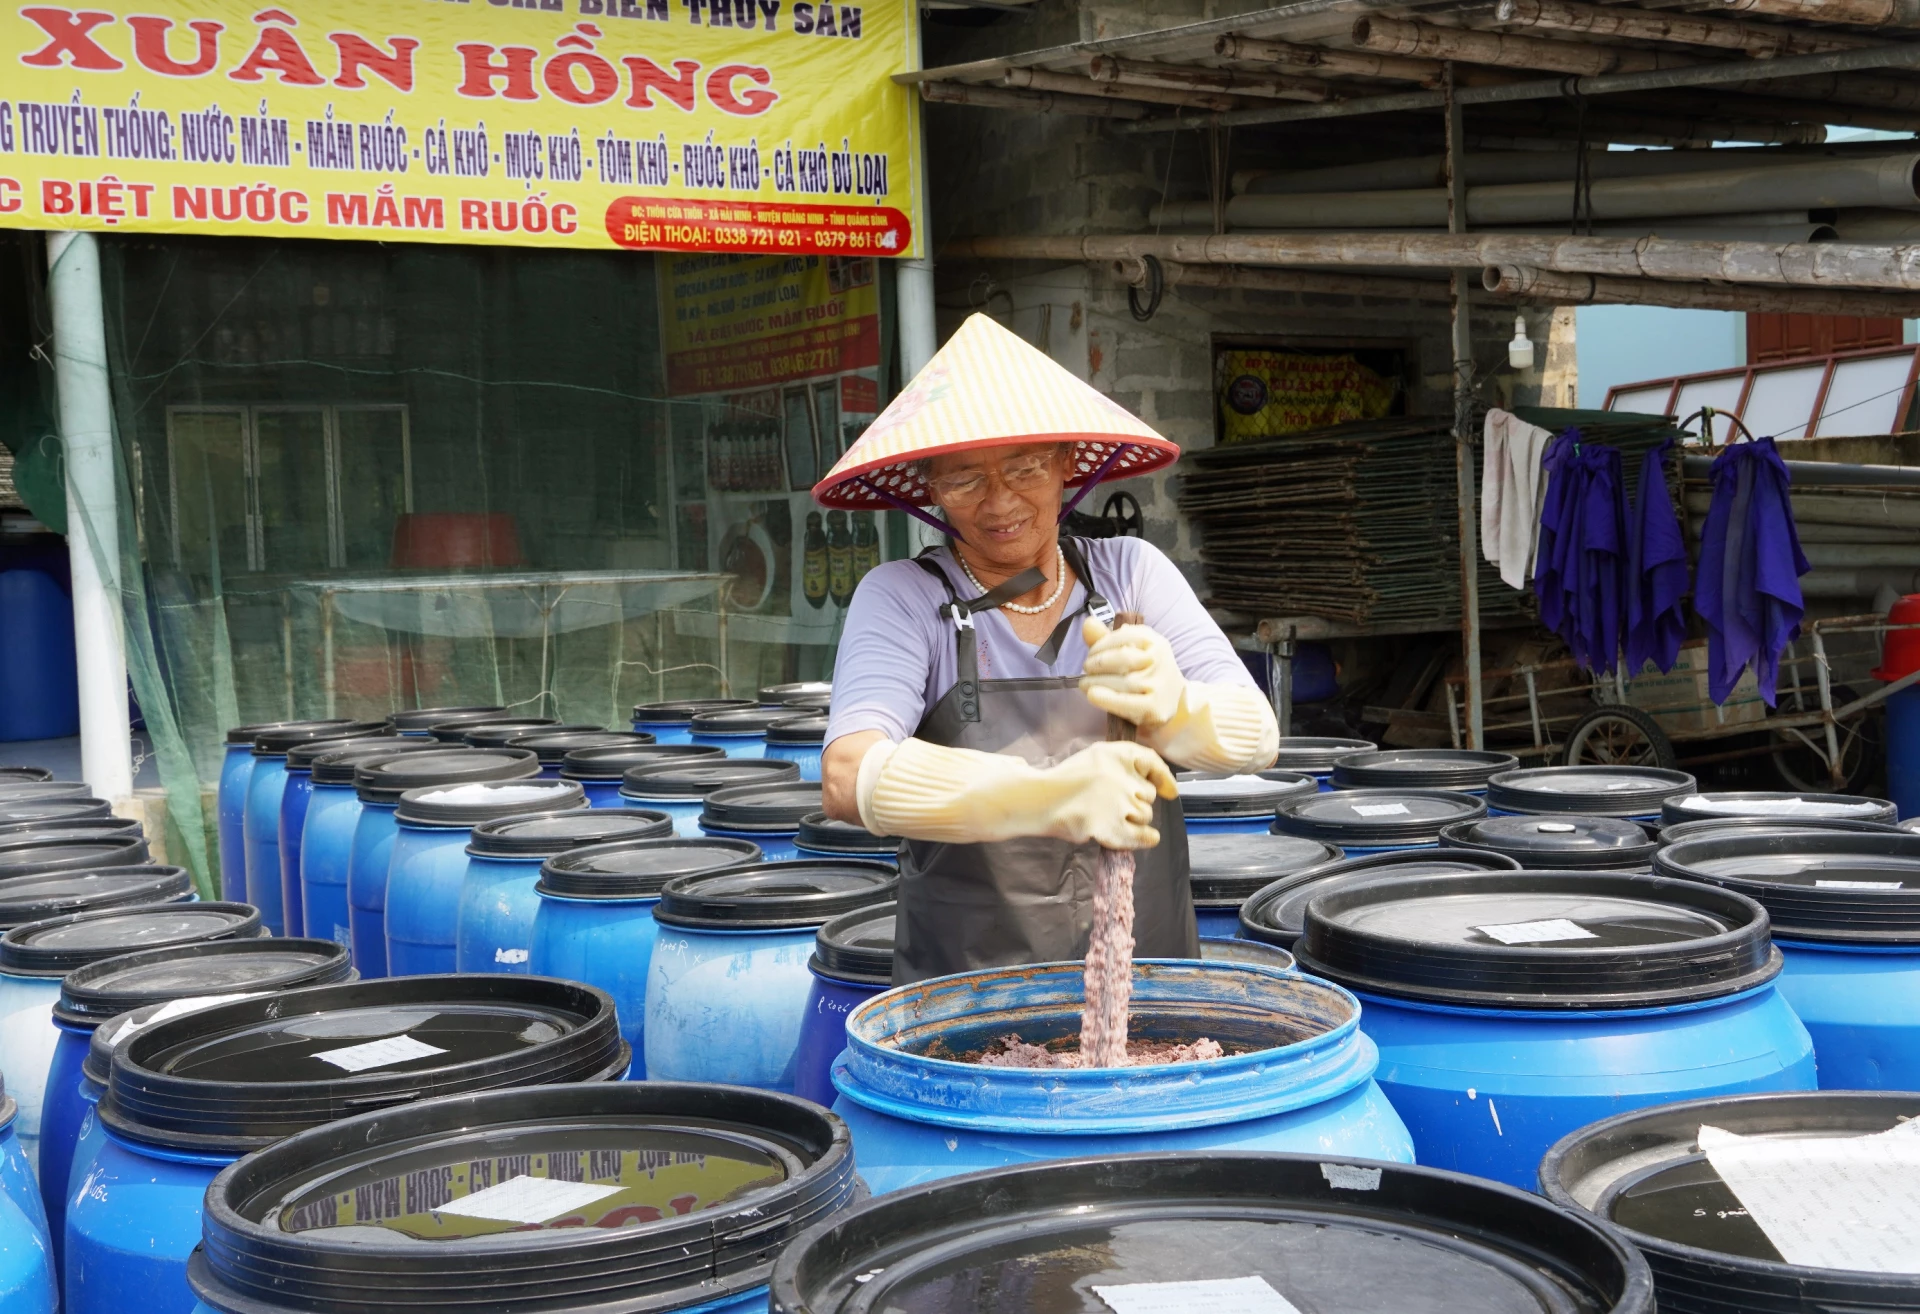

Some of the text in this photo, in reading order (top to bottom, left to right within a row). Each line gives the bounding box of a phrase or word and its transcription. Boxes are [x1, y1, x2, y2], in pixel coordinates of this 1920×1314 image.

[21, 9, 779, 116] XUÂN HỒNG
[18, 89, 98, 156] TRUYỀN
[103, 92, 176, 160] THỐNG:
[181, 104, 235, 164] NƯỚC
[241, 99, 289, 166] MẮM
[307, 104, 355, 169] MẮM
[359, 109, 408, 173] RUỐC
[425, 119, 450, 174] CÁ
[453, 121, 488, 177] KHÔ
[505, 130, 543, 189] MỰC
[548, 127, 582, 181] KHÔ
[596, 130, 632, 183] TÔM
[636, 133, 668, 186] KHÔ
[683, 130, 724, 189] RUỐC
[729, 138, 760, 191] KHÔ
[774, 141, 796, 192] CÁ
[798, 143, 829, 194] KHÔ
[831, 139, 853, 195] ĐỦ
[855, 153, 888, 206] LOẠI
[42, 176, 154, 224] BIỆT
[173, 183, 309, 224] NƯỚC
[326, 184, 444, 229] MẮM
[461, 192, 577, 234] RUỐC
[624, 220, 660, 246] ĐIỆN
[664, 226, 711, 246] THOẠI:
[715, 227, 748, 245] 0338
[751, 228, 774, 246] 721
[778, 229, 802, 247] 621
[814, 231, 847, 248] 0379
[849, 233, 872, 248] 861
